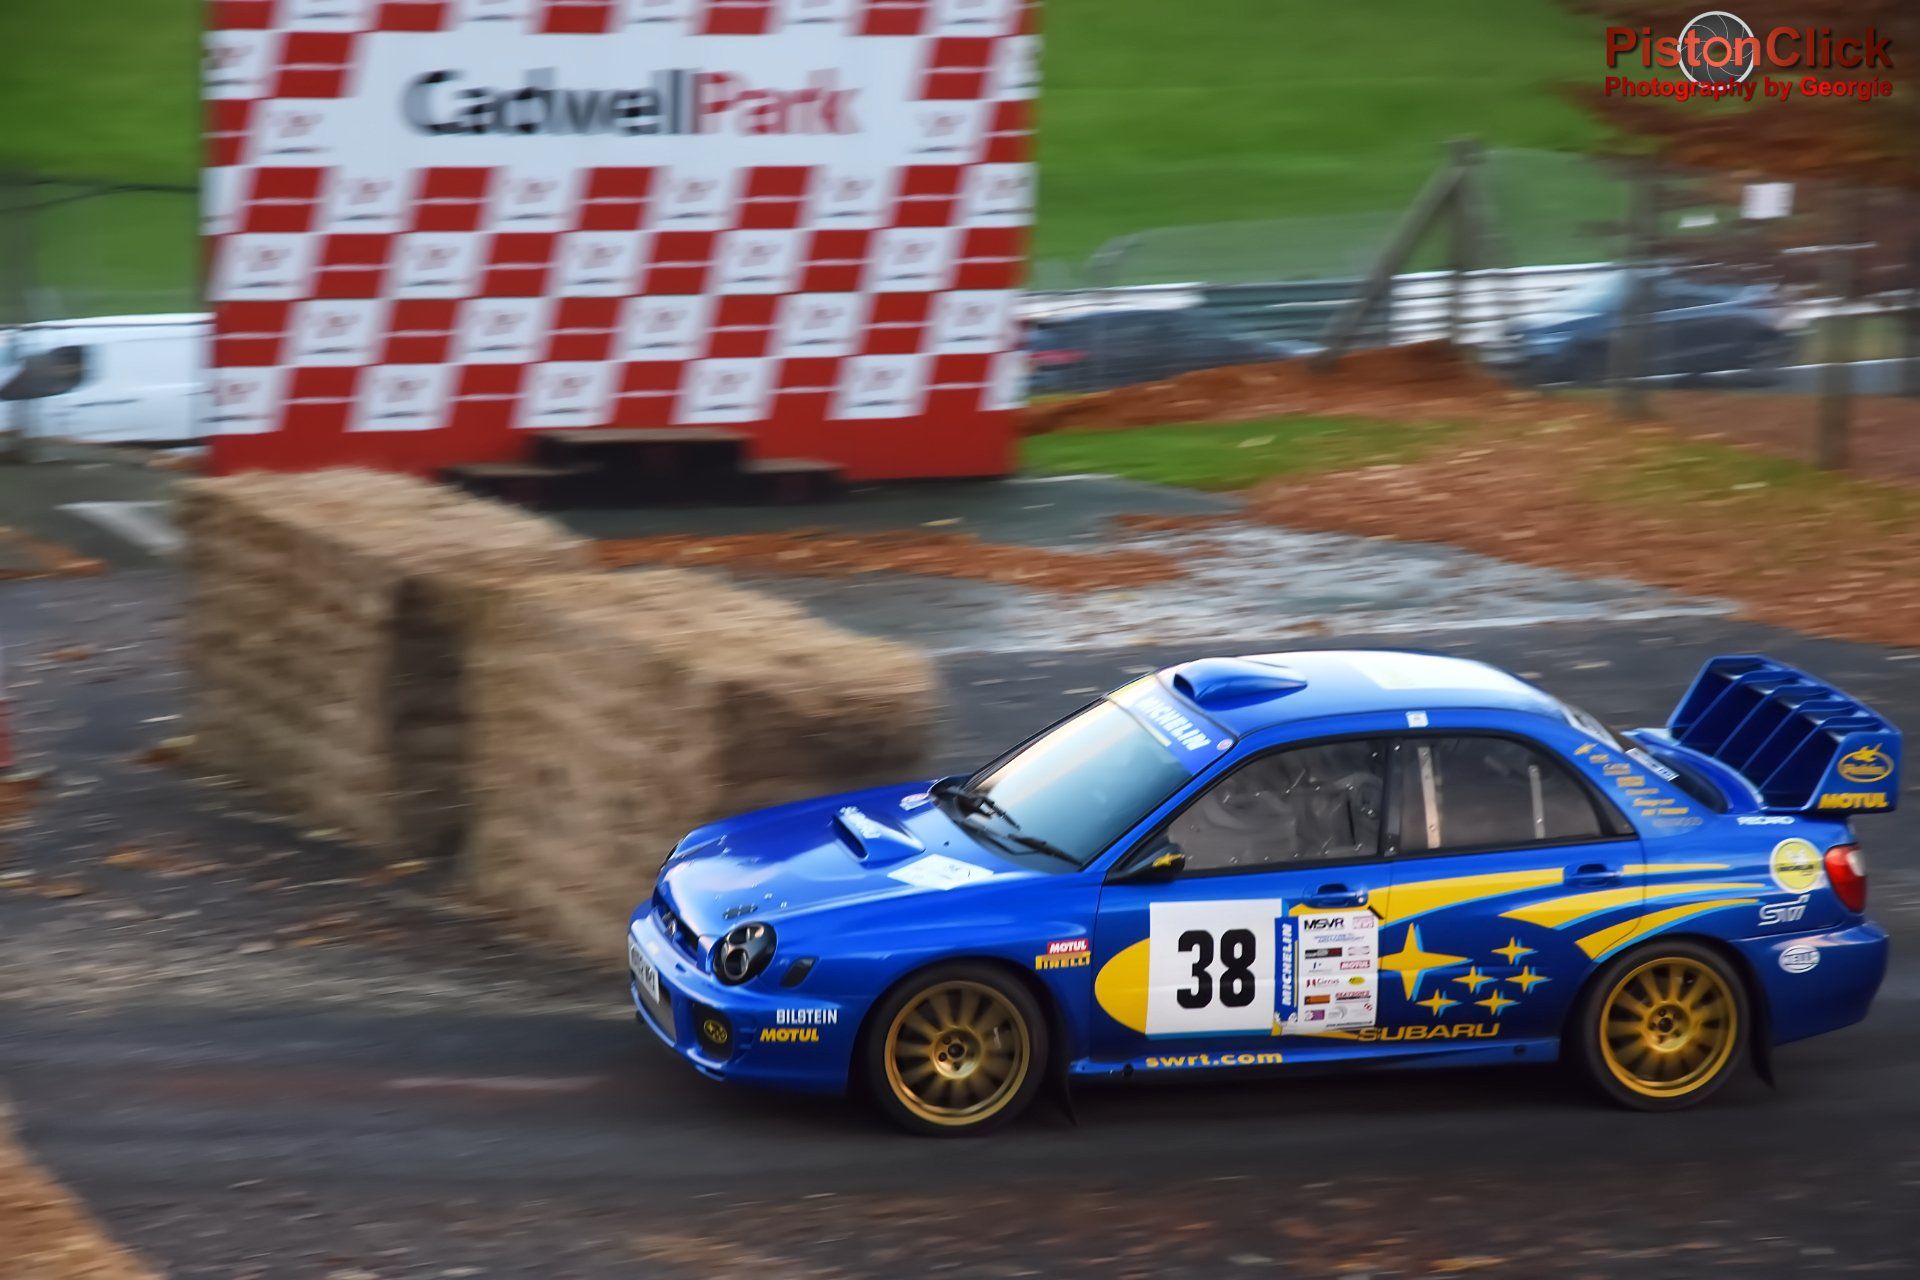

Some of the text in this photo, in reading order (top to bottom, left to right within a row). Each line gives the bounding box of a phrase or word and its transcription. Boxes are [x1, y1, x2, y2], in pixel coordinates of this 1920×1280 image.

[1818, 792, 1888, 809] MOTUL
[1304, 918, 1344, 930] MSVR
[1050, 940, 1087, 954] MOTUL
[1035, 951, 1091, 970] PIRELLI
[1176, 928, 1257, 1010] 38
[1282, 923, 1292, 1007] MICHELIN
[776, 1009, 837, 1025] BILSTEIN
[760, 1028, 819, 1042] MOTUL
[1358, 1023, 1500, 1042] SUBARU
[1145, 1051, 1284, 1068] swrt.com
